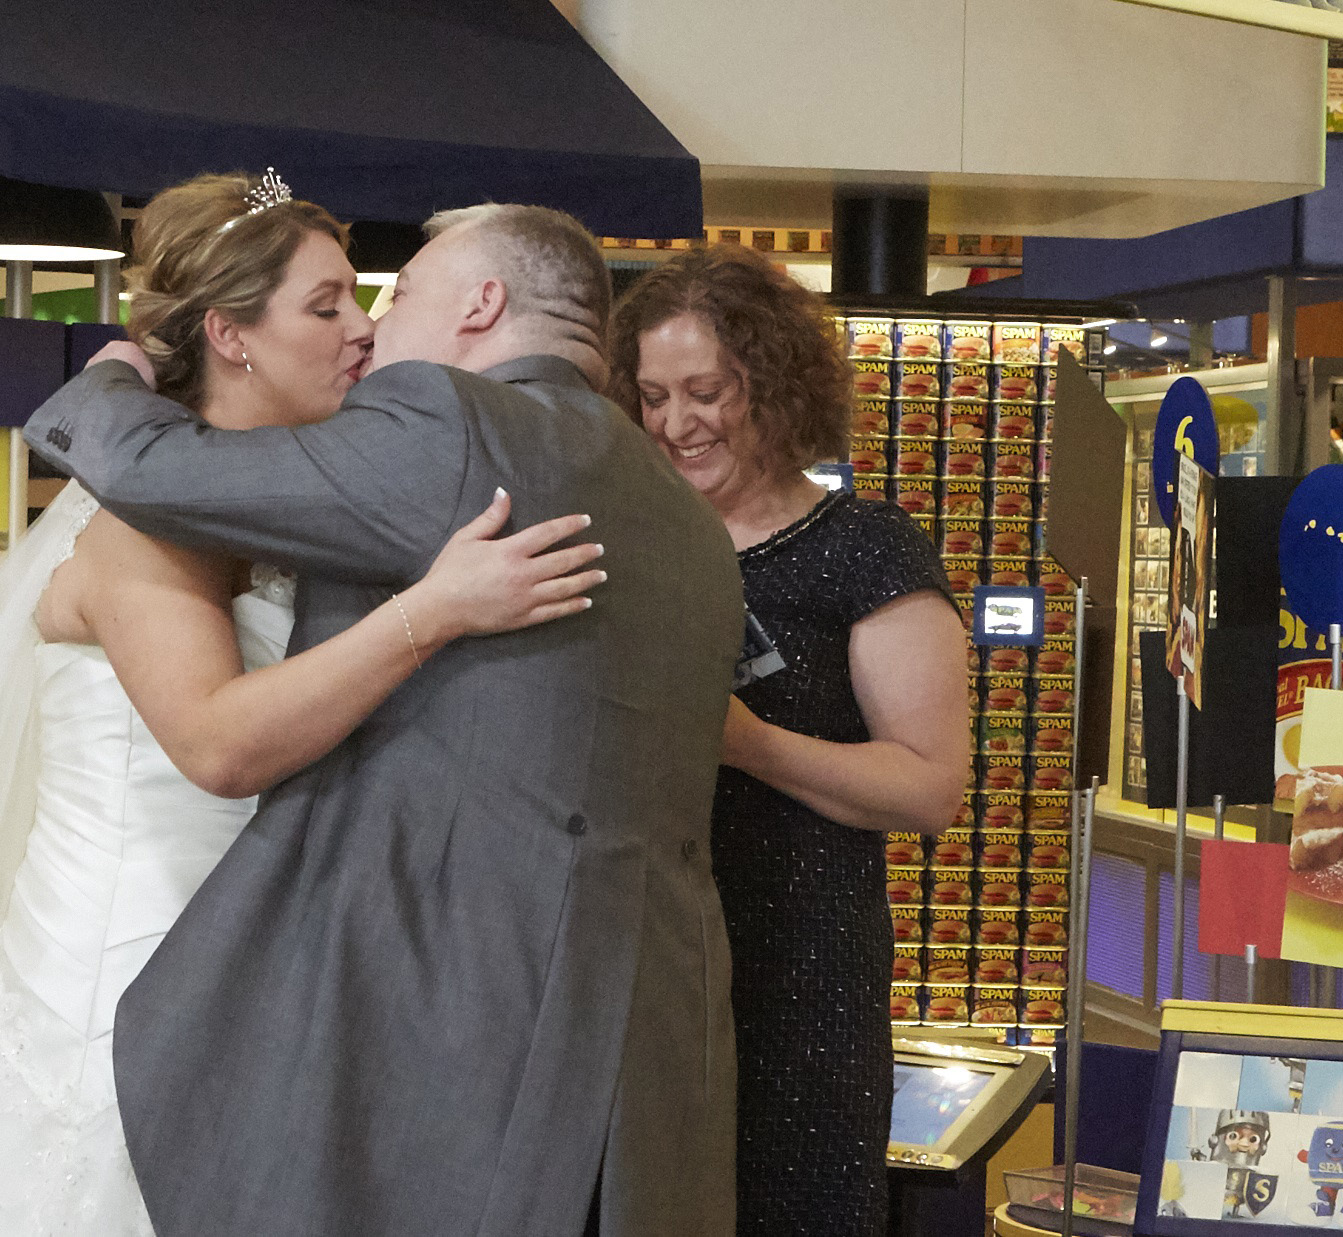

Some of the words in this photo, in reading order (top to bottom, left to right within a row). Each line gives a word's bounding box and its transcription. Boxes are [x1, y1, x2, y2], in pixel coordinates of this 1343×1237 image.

[856, 322, 890, 336] SPAM
[904, 324, 938, 336] SPAM
[954, 326, 988, 337] SPAM
[1002, 328, 1035, 339] SPAM
[1051, 329, 1084, 341] SPAM
[855, 362, 888, 374] SPAM
[904, 363, 936, 375] SPAM
[953, 365, 986, 376] SPAM
[1001, 366, 1033, 378] SPAM
[902, 403, 935, 414] SPAM
[951, 404, 983, 415] SPAM
[1000, 405, 1032, 417] SPAM
[900, 442, 932, 453] SPAM
[949, 443, 982, 454] SPAM
[998, 445, 1030, 456] SPAM
[852, 480, 884, 491] SPAM
[900, 481, 932, 492] SPAM
[948, 482, 980, 493] SPAM
[997, 483, 1028, 495] SPAM
[946, 521, 979, 532] SPAM
[996, 522, 1028, 534] SPAM
[945, 560, 977, 571] SPAM
[993, 561, 1026, 572] SPAM
[991, 678, 1023, 688] SPAM
[1040, 680, 1072, 690] SPAM
[989, 718, 1022, 728] SPAM
[1038, 719, 1070, 729] SPAM
[989, 757, 1022, 766] SPAM
[1037, 758, 1069, 767] SPAM
[988, 796, 1020, 806] SPAM
[1036, 797, 1068, 806] SPAM
[888, 832, 920, 842] SPAM
[938, 834, 970, 843] SPAM
[985, 835, 1018, 844] SPAM
[1034, 836, 1067, 845] SPAM
[887, 870, 919, 881] SPAM
[936, 871, 968, 882] SPAM
[984, 872, 1017, 883] SPAM
[1032, 874, 1065, 885] SPAM
[935, 909, 967, 920] SPAM
[984, 911, 1016, 922] SPAM
[1031, 912, 1063, 923] SPAM
[934, 949, 966, 960] SPAM
[981, 950, 1014, 960] SPAM
[1029, 951, 1062, 962] SPAM
[932, 988, 965, 998] SPAM
[980, 990, 1013, 1000] SPAM
[1029, 990, 1062, 1001] SPAM
[1319, 1162, 1343, 1174] SPA
[1253, 1179, 1270, 1202] S
